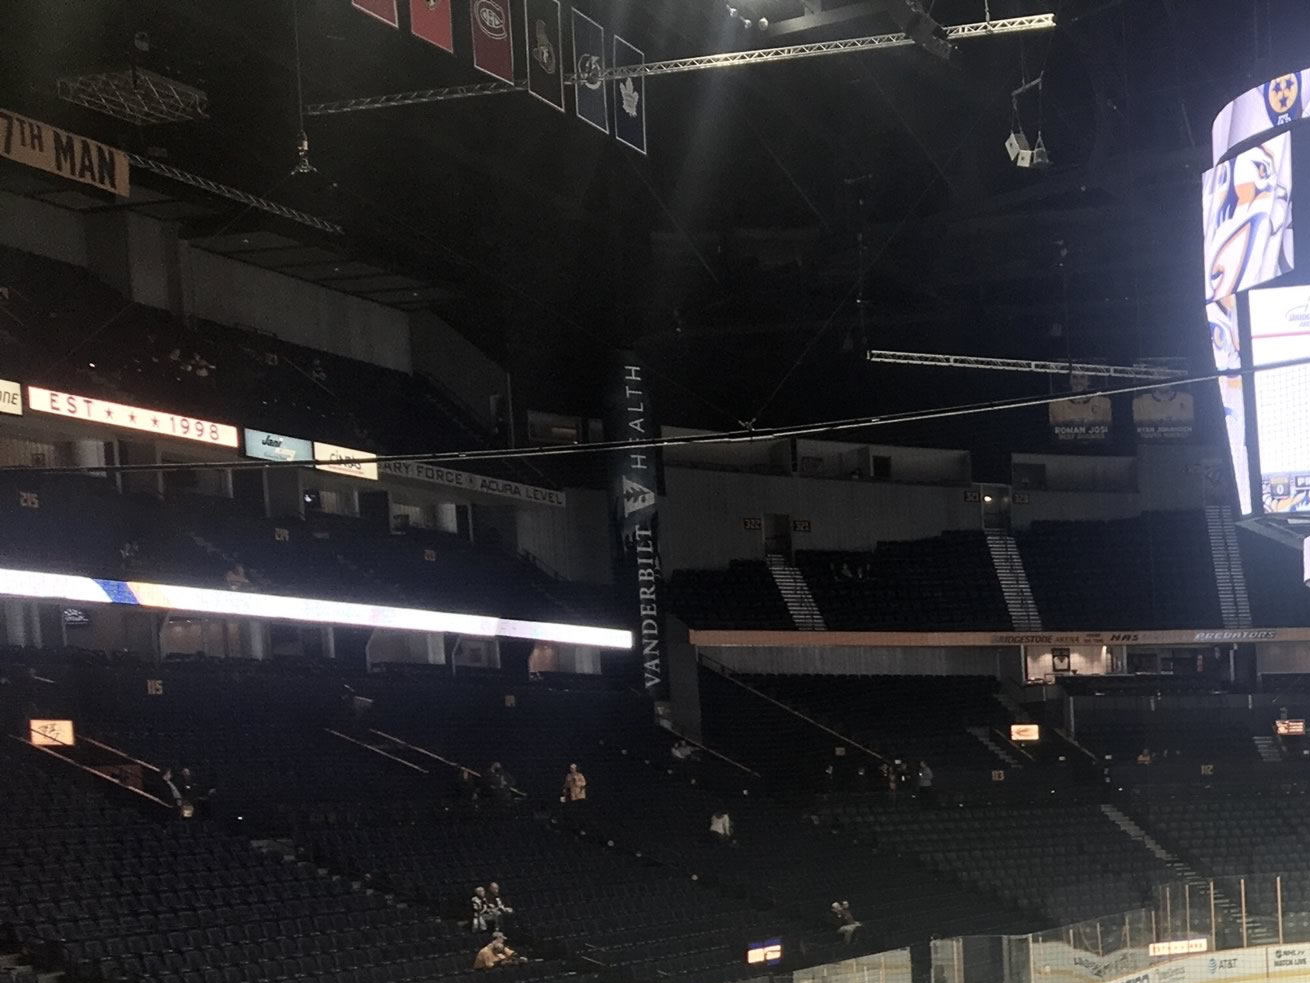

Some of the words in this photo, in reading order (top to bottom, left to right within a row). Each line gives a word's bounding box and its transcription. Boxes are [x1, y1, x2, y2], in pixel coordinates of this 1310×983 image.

[53, 130, 117, 190] MAN
[50, 393, 93, 418] EST
[170, 416, 219, 441] 1998
[625, 366, 648, 470] HALTH
[1055, 426, 1086, 434] ROMAN
[1088, 426, 1109, 434] JOSI
[378, 462, 412, 475] ARY
[417, 465, 463, 485] FORCE
[480, 478, 522, 497] ACURA
[525, 486, 563, 505] LEVEL
[1277, 484, 1284, 495] 0
[636, 524, 662, 689] VANDERBILT
[1195, 630, 1277, 641] PREDATORS
[1218, 958, 1238, 969] AT&T
